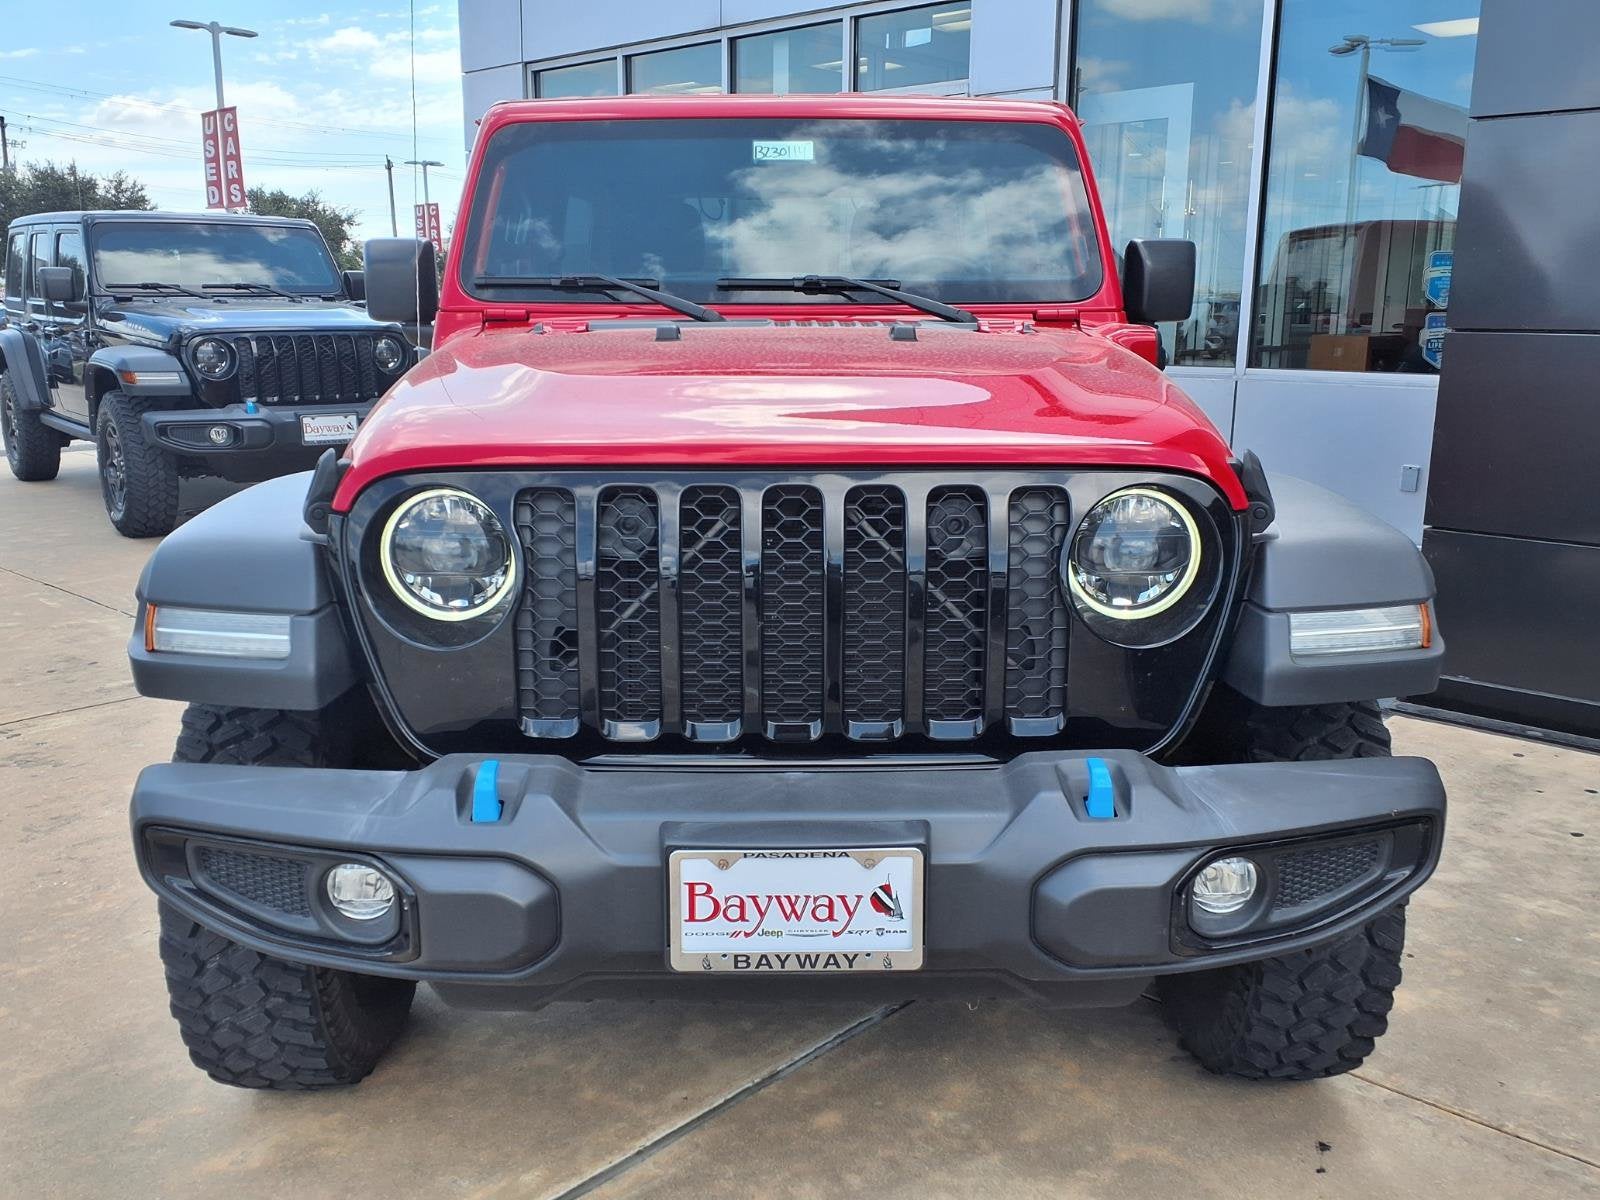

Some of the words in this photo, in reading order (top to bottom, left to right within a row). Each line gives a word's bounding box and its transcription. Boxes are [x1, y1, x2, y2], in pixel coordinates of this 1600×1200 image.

[204, 116, 220, 204] USED
[224, 112, 242, 203] CARS
[416, 206, 425, 241] USE
[429, 205, 440, 251] CARS
[304, 422, 346, 437] Bayway
[743, 851, 850, 859] PASADENA
[683, 881, 864, 938] Bayway
[757, 928, 784, 939] Jeep
[733, 953, 859, 970] BAYWAY
